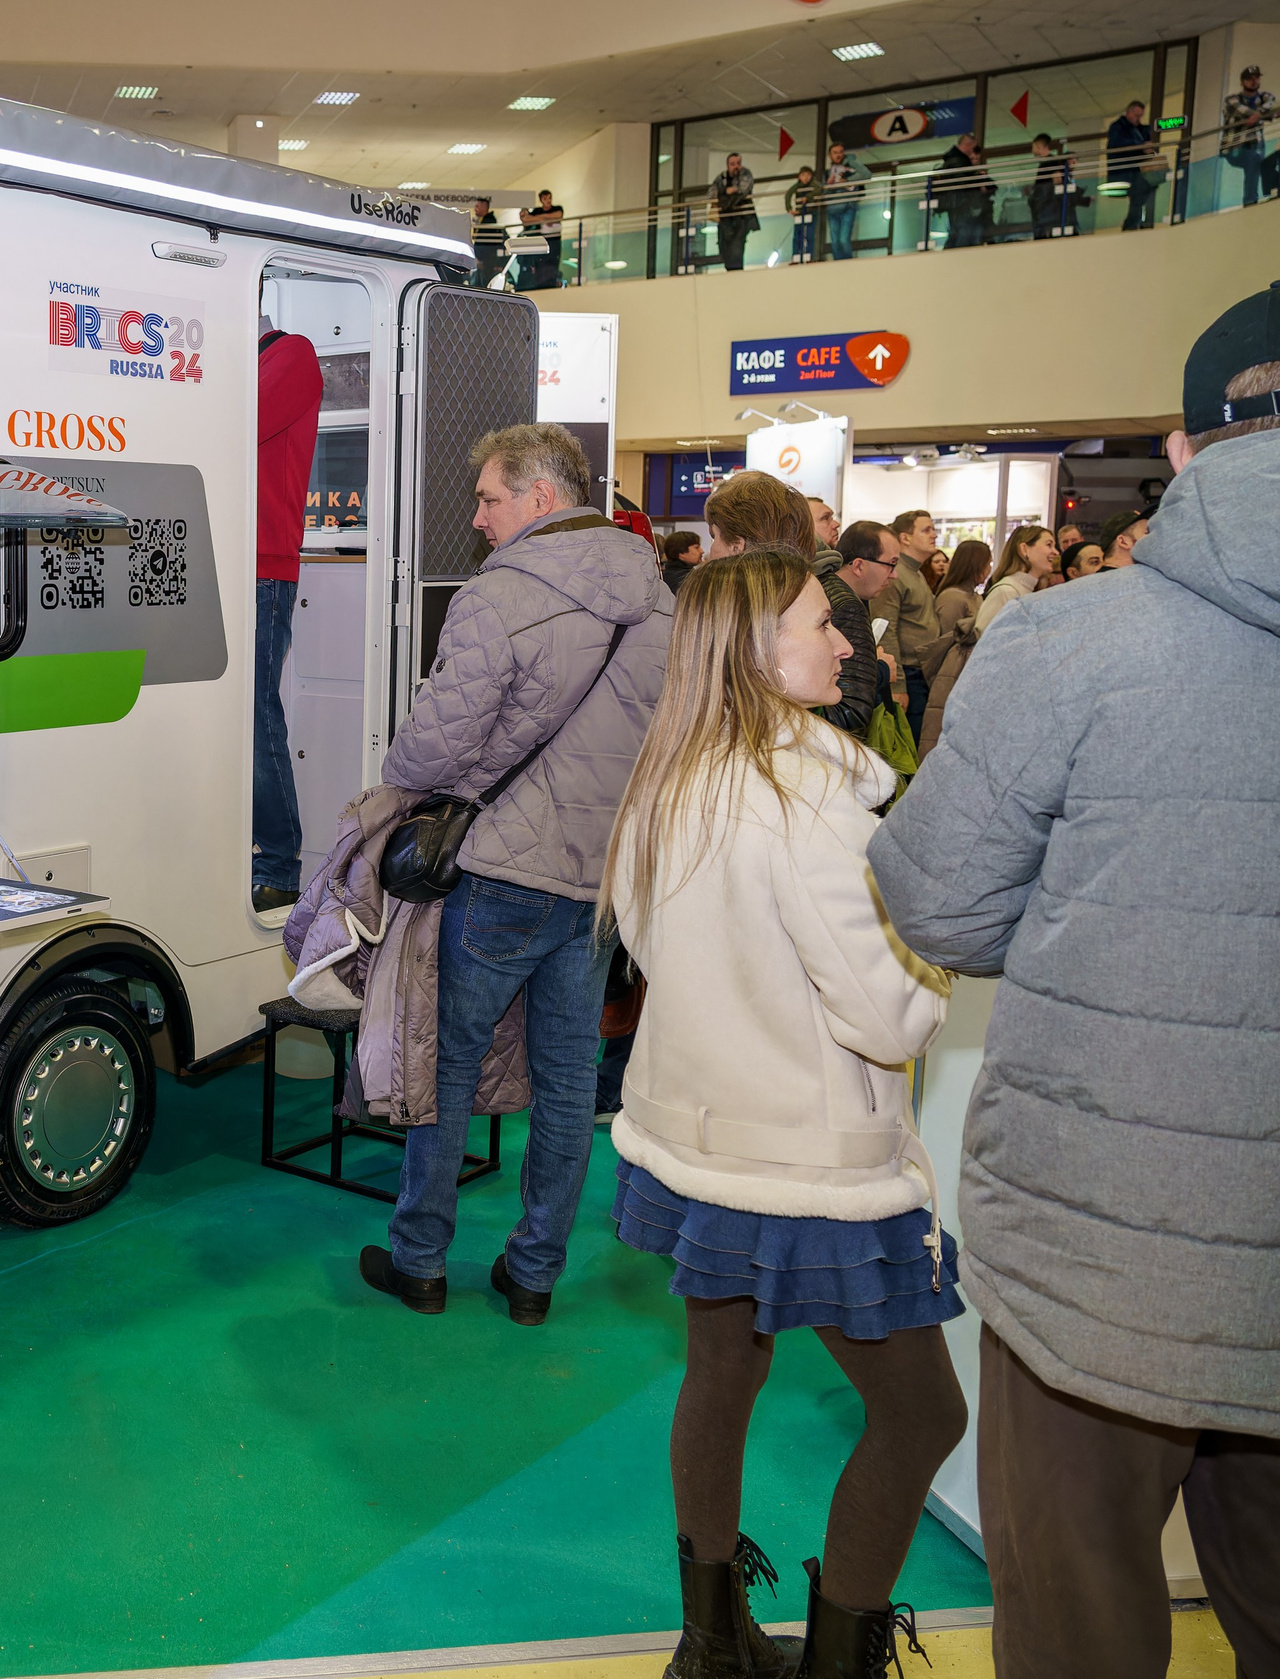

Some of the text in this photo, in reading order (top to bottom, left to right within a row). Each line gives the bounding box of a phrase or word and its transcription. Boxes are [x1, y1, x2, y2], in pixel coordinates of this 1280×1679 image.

[887, 114, 909, 137] A
[49, 281, 100, 297] участник
[168, 316, 204, 350] 20
[109, 350, 203, 383] RUSSIA 24
[736, 350, 785, 371] КАФЕ
[796, 346, 841, 367] CAFE
[799, 369, 836, 381] 2nd Floor
[1223, 403, 1232, 422] FILA
[7, 409, 127, 453] GROSS
